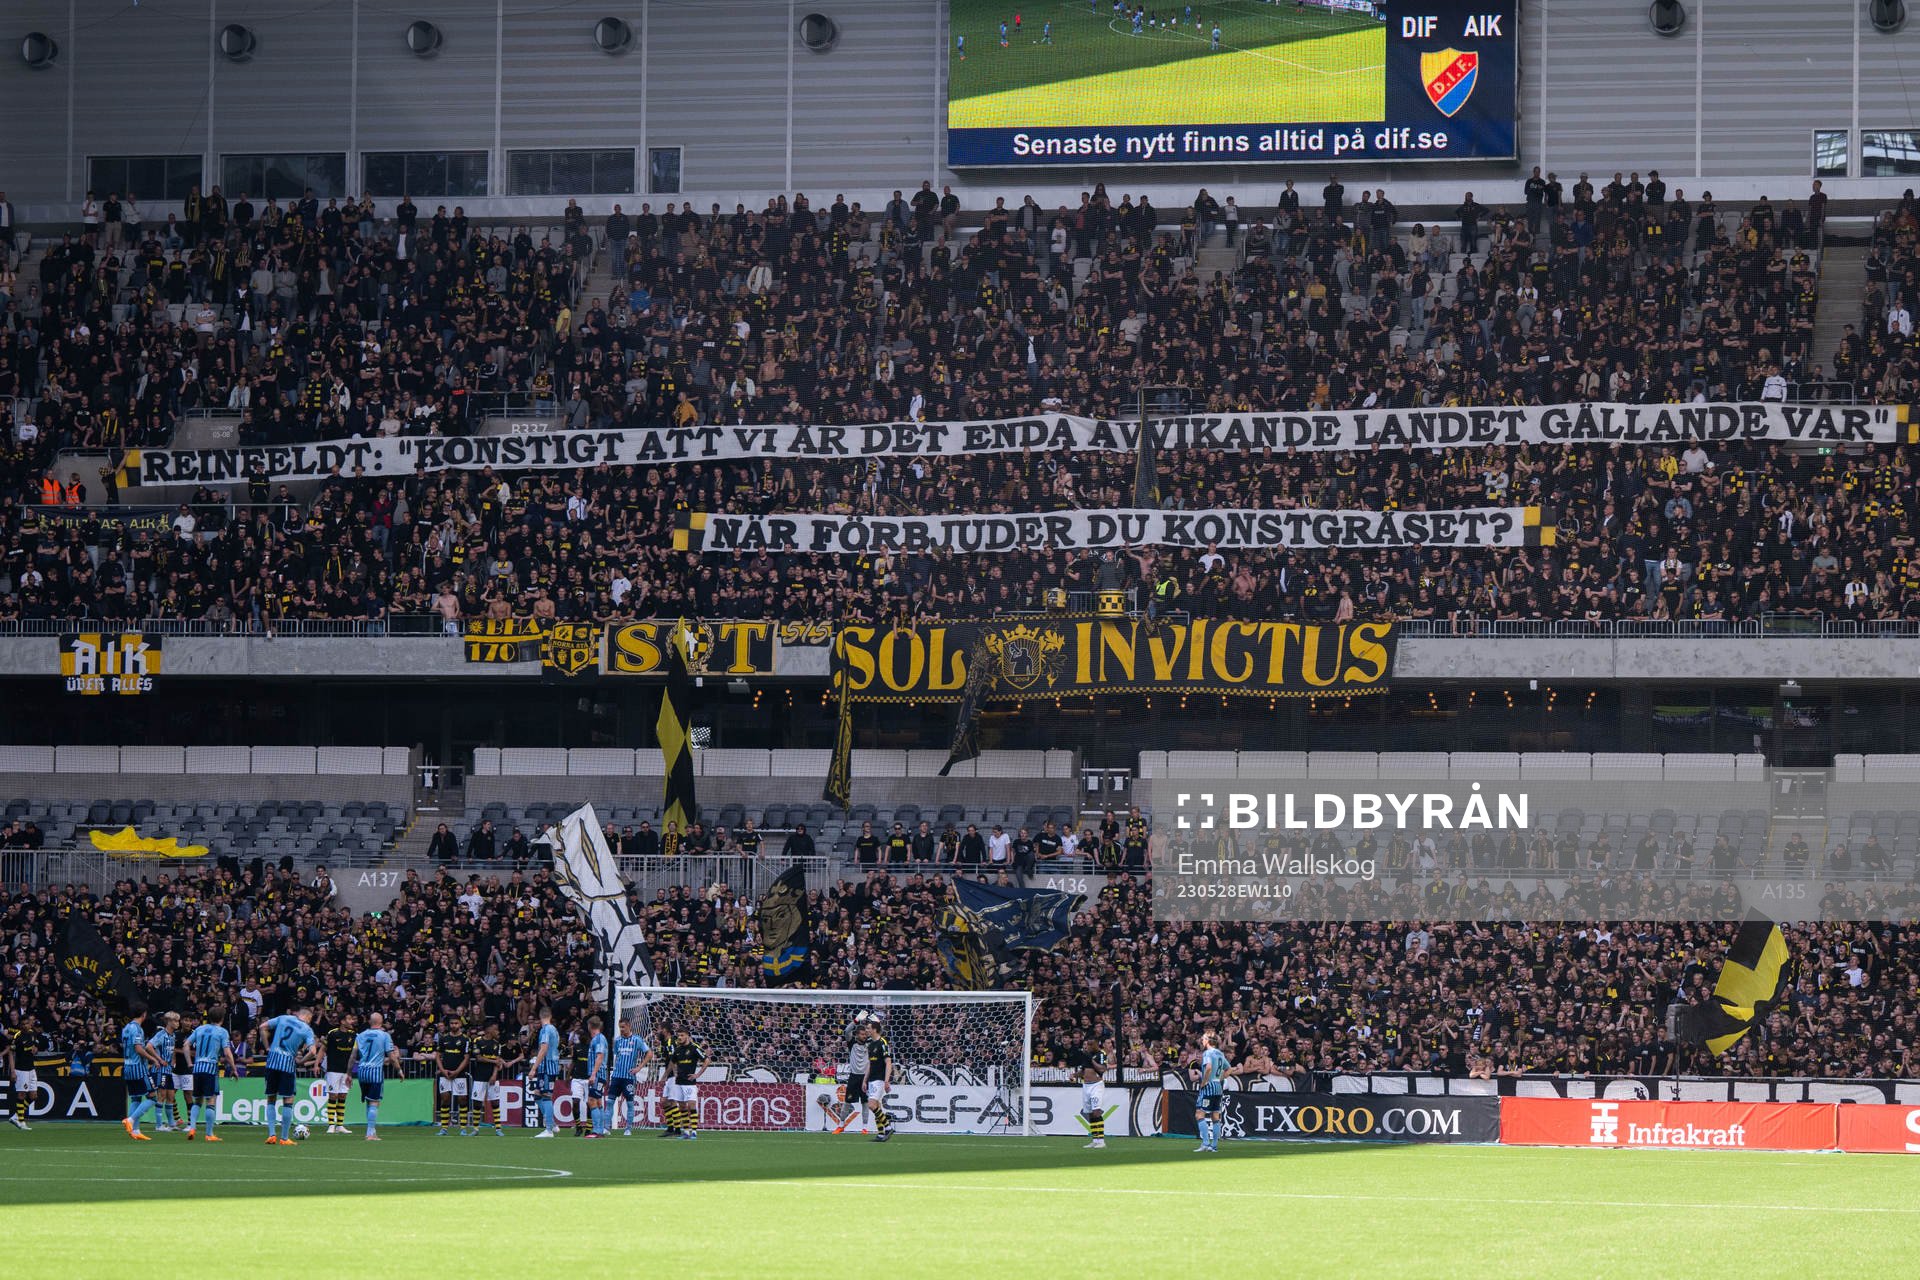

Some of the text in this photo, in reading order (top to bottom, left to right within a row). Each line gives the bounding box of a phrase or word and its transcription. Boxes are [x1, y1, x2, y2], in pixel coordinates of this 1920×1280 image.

[1402, 15, 1503, 38] DIF AIK
[1013, 127, 1448, 159] Senaste nytt finns alltid på dif.se
[399, 432, 625, 469] "KONSTIGT
[636, 427, 723, 461] ATT
[733, 427, 777, 453] VI
[787, 423, 849, 455] ÄR
[860, 424, 950, 454] DET
[962, 418, 1077, 451] ENDA
[1088, 416, 1342, 449] AVVIKANDE
[1353, 409, 1528, 445] LANDET
[1539, 403, 1770, 441] GÄLLANDE
[1781, 407, 1889, 441] VAR"
[710, 514, 800, 551] NÄR
[809, 515, 1083, 552] FÖRBJUDER
[1086, 513, 1151, 545] DU
[70, 639, 151, 676] AIK
[833, 618, 1393, 692] SOL INVICTUS
[111, 677, 153, 692] ALLES
[357, 871, 400, 888] A137
[1046, 877, 1088, 894] A136
[1761, 883, 1806, 900] A135
[279, 1025, 295, 1050] 2
[365, 1039, 375, 1064] 7
[881, 1093, 1054, 1126] SEFAB
[1255, 1104, 1463, 1136] FXORO.COM
[1627, 1122, 1746, 1147] Infrakraft
